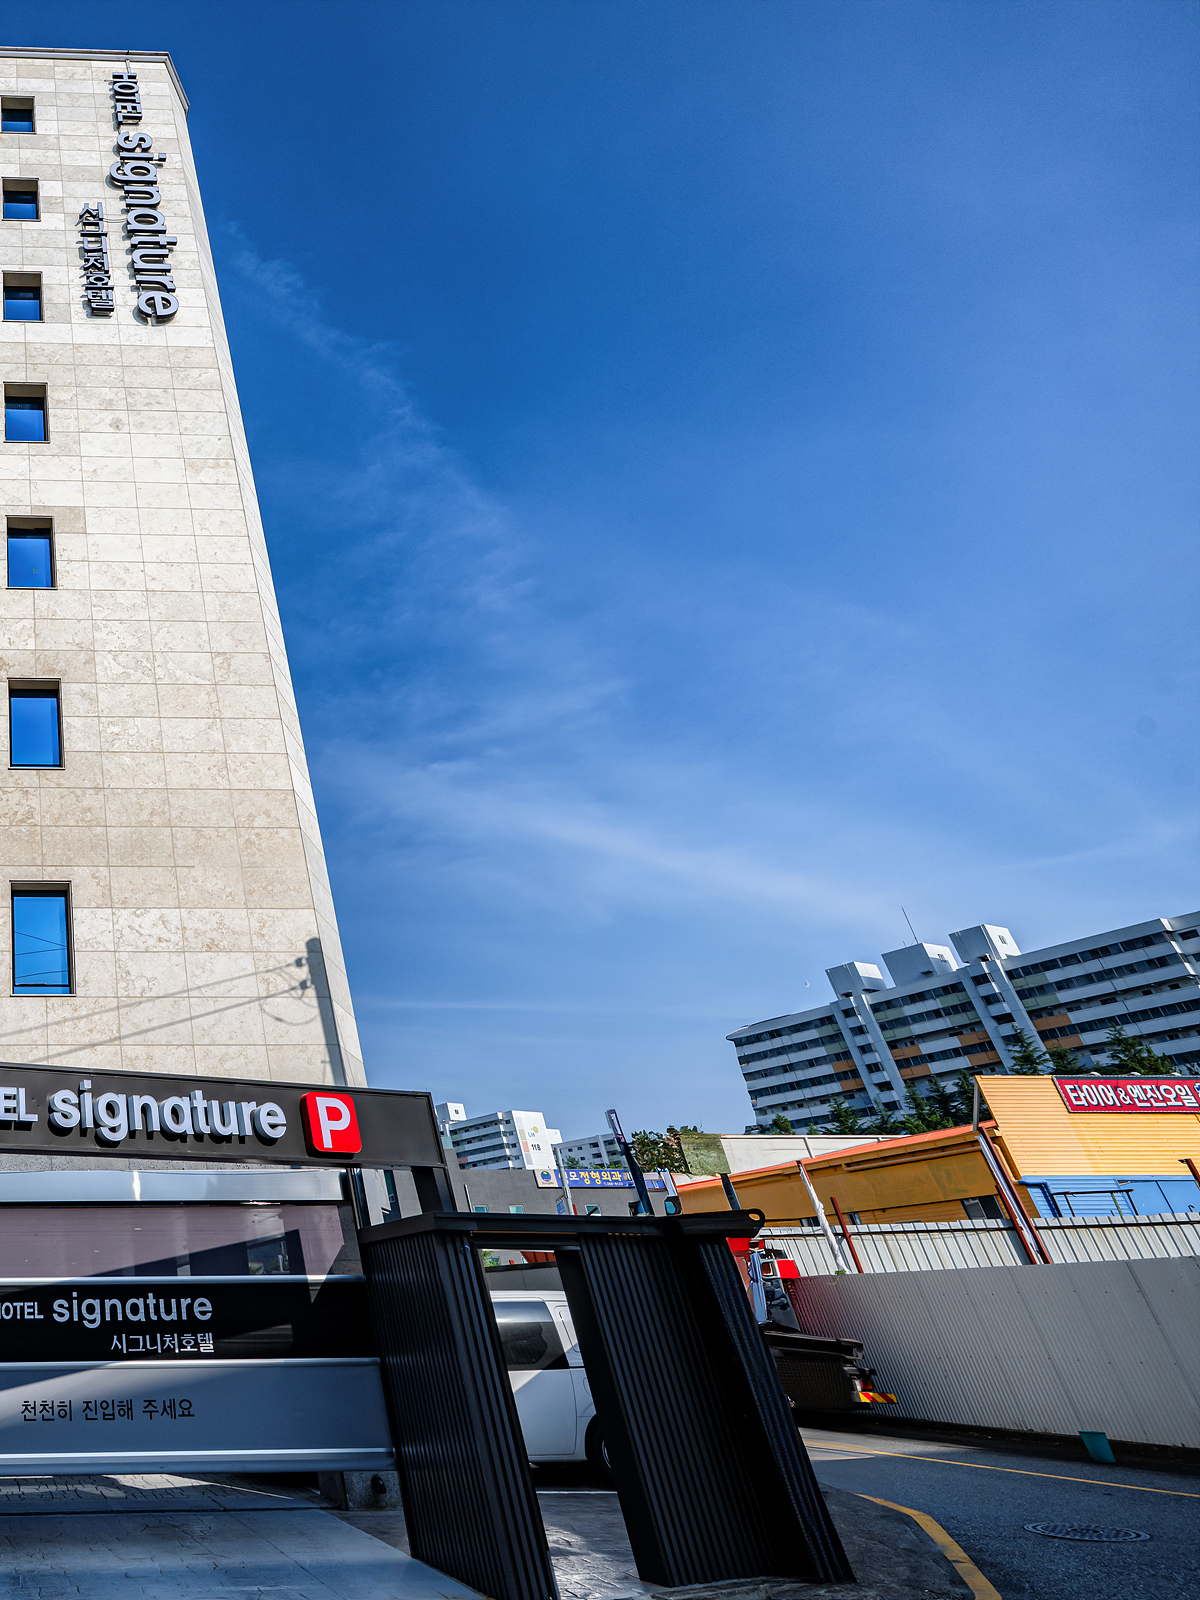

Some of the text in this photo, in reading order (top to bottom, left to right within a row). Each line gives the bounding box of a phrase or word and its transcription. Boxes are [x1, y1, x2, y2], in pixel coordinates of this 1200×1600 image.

[110, 72, 179, 319] HOTEL signature
[79, 201, 115, 316] 시그니처호텔
[49, 1079, 287, 1142] signature
[314, 1096, 352, 1149] P
[52, 1292, 213, 1329] signature
[110, 1332, 215, 1354] 시그니처호텔
[20, 1398, 196, 1422] 천천히 진입해 주세요
